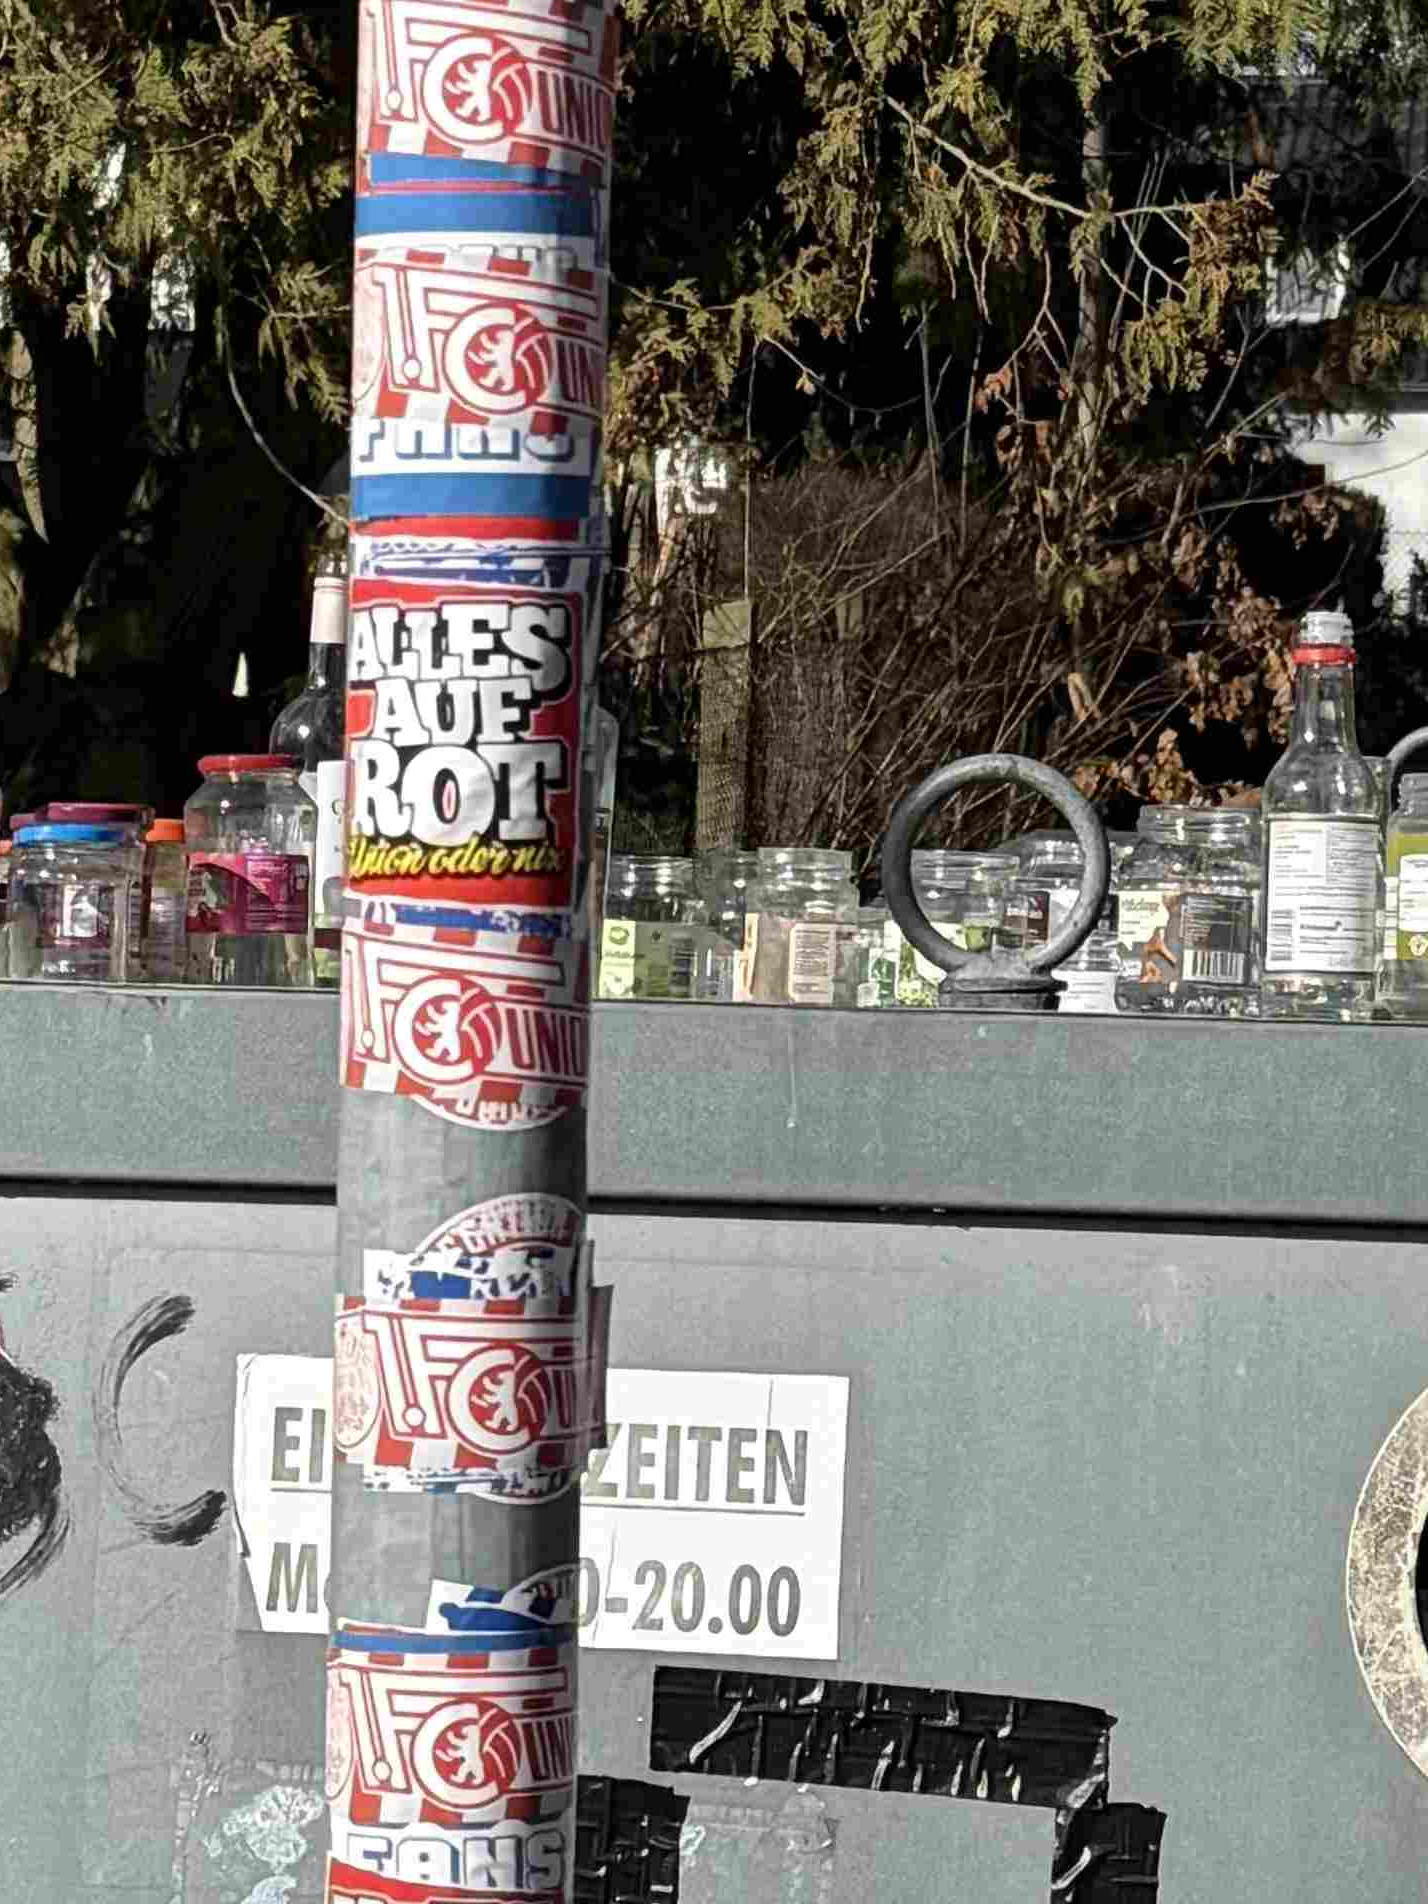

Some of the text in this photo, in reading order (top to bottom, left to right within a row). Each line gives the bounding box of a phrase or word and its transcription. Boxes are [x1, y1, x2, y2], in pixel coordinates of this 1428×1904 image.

[348, 602, 568, 691] ALLES
[374, 677, 532, 746] AUF
[352, 739, 562, 847] ROT
